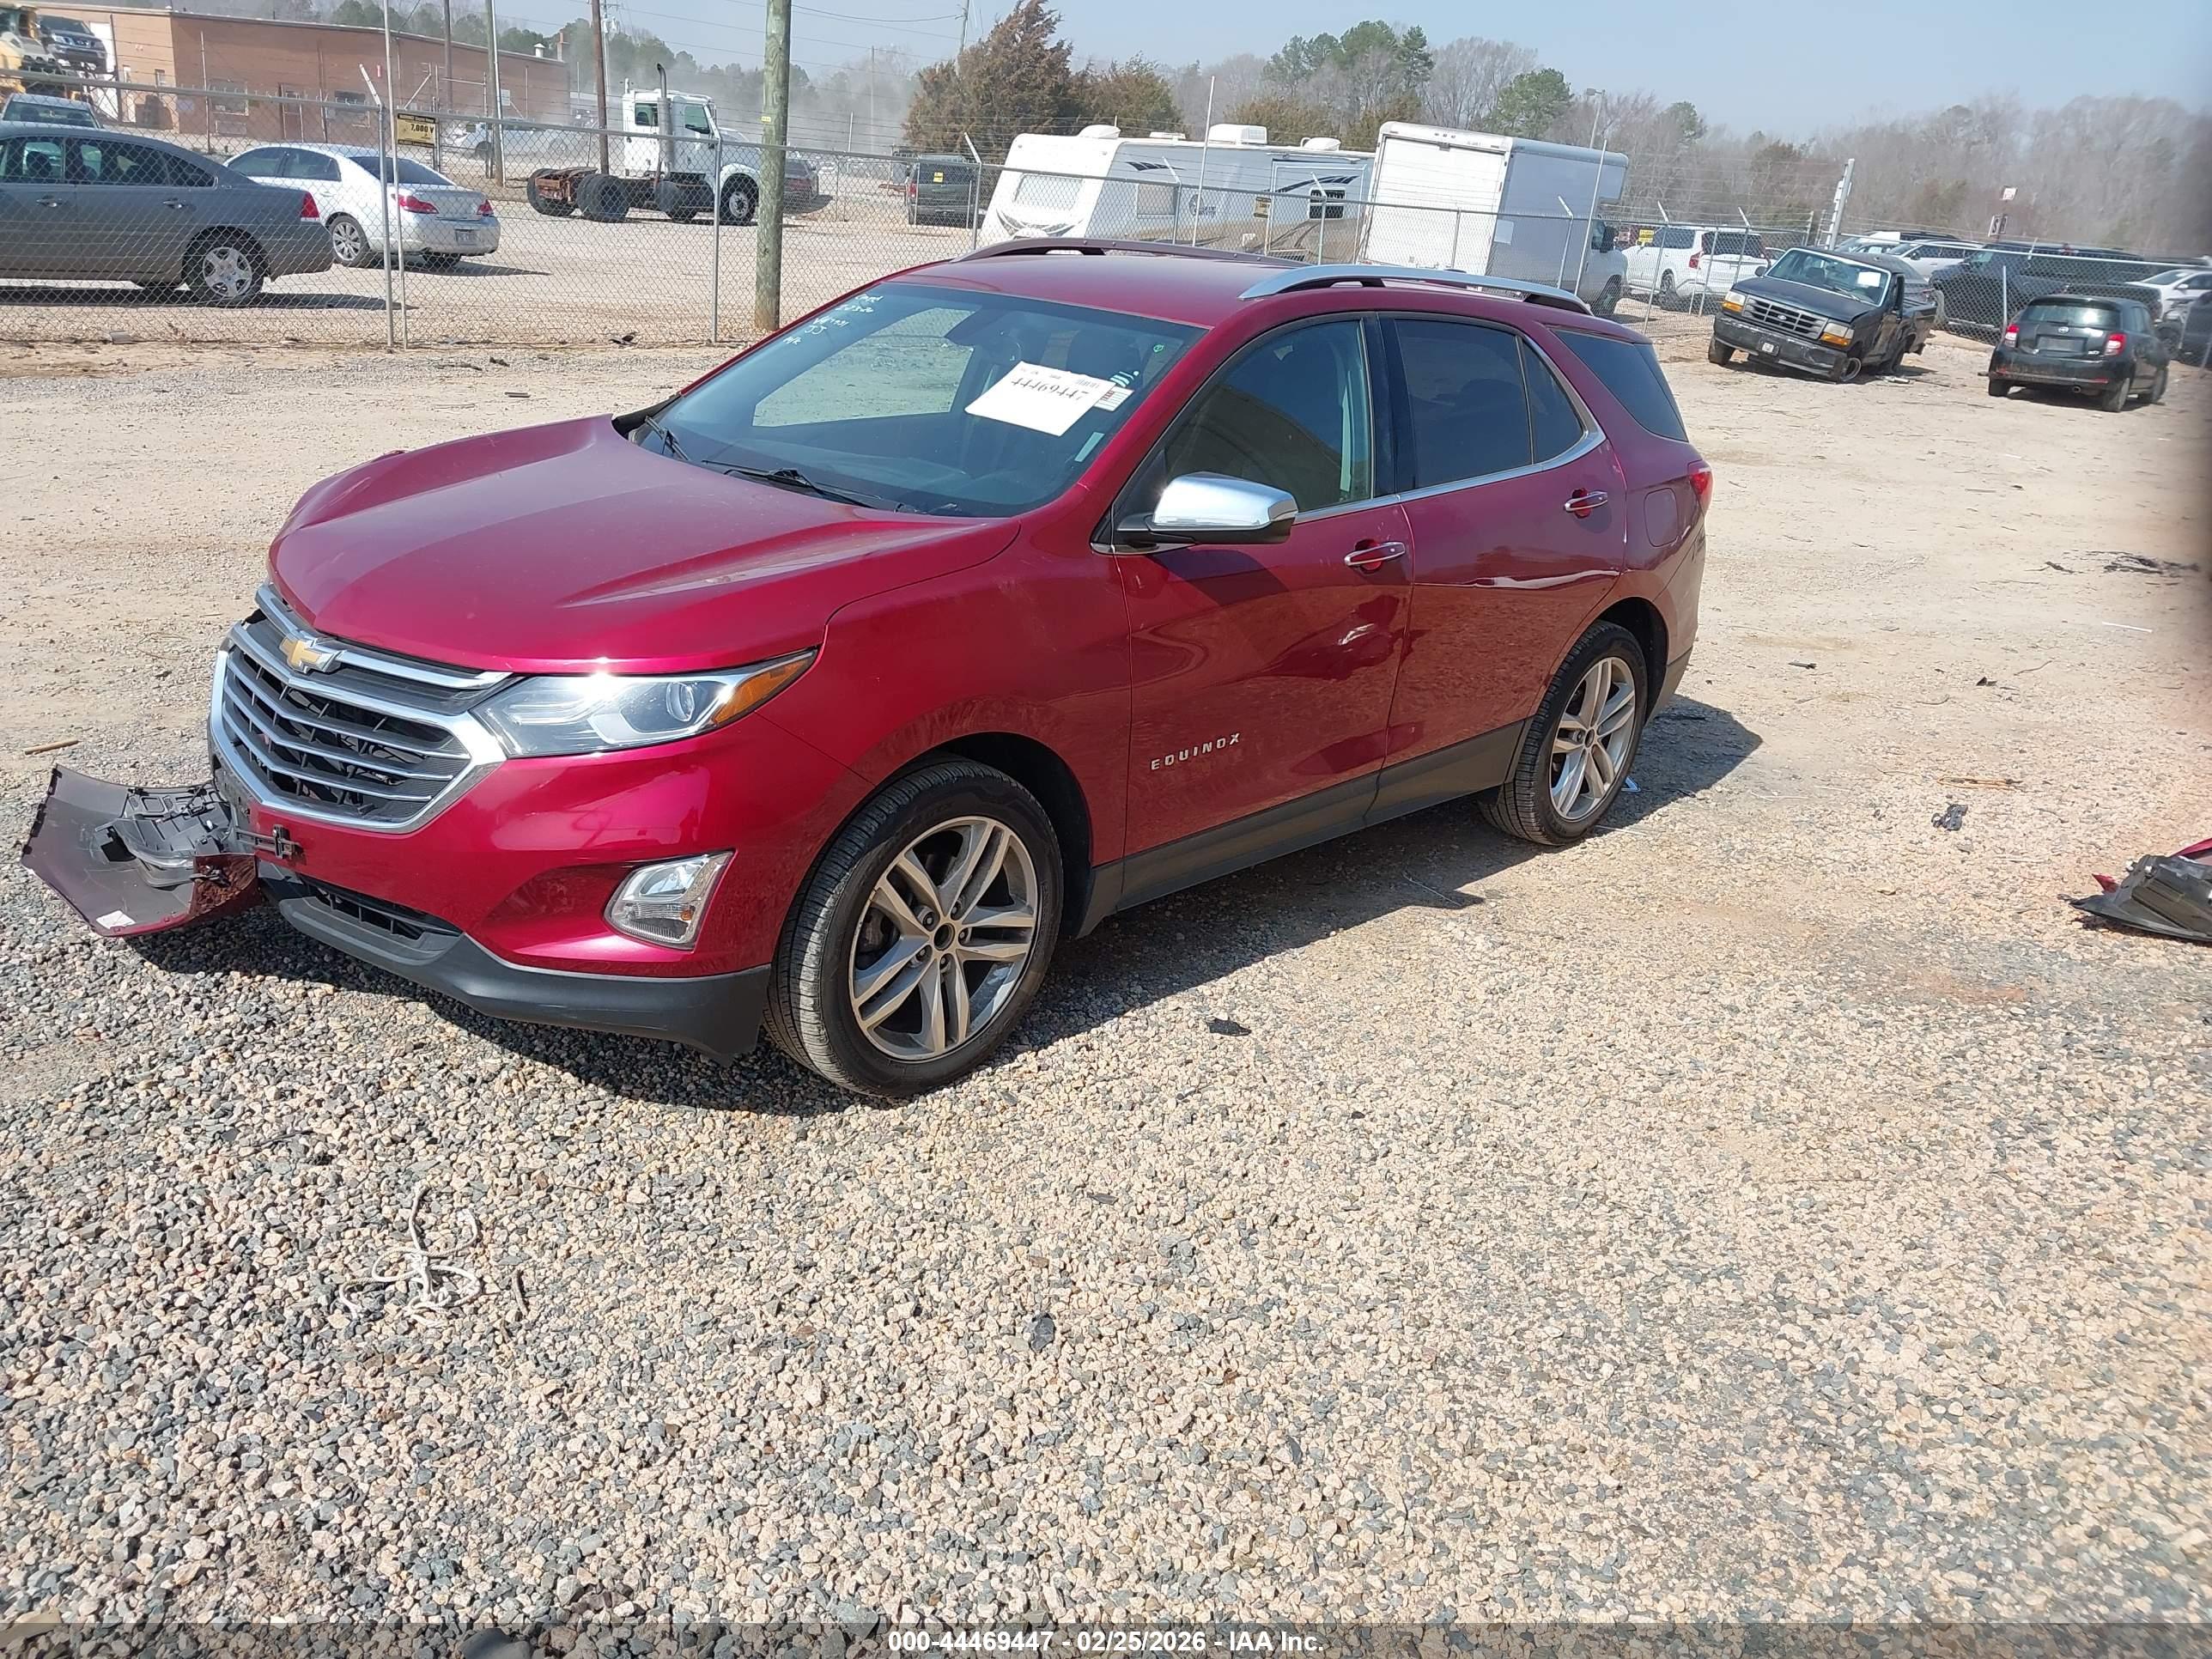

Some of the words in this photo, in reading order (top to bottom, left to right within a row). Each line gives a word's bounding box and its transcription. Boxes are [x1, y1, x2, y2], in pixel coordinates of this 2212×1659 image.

[410, 124, 428, 132] 7,000
[1011, 377, 1089, 400] 44469447
[1151, 732, 1240, 770] EQUINOX
